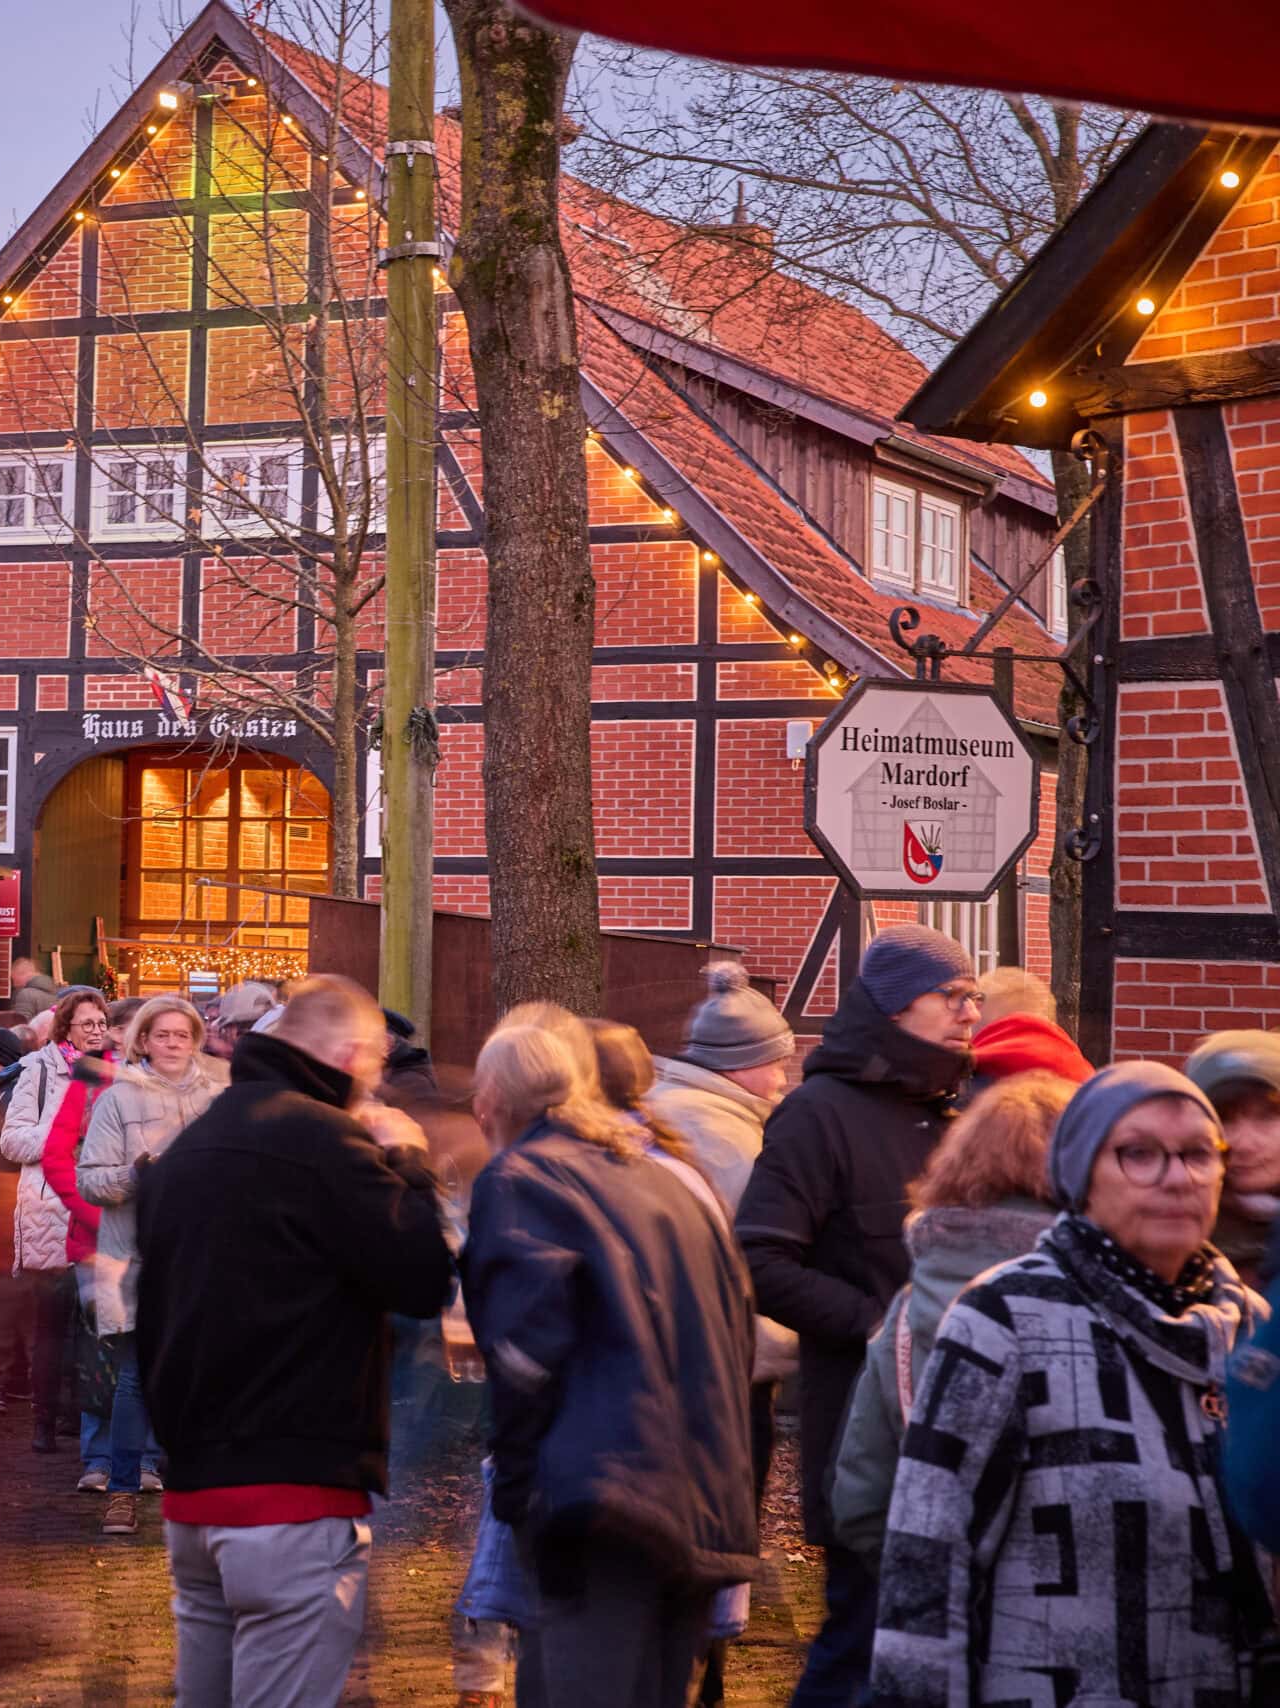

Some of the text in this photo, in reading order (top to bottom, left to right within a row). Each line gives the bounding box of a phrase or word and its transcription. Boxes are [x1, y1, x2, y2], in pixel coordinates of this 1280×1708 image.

[82, 713, 297, 744] Haus des Gastes
[840, 726, 1015, 758] Heimatmuseum
[880, 762, 971, 788] Mardorf
[889, 795, 921, 809] Josef
[923, 796, 960, 811] Boslar
